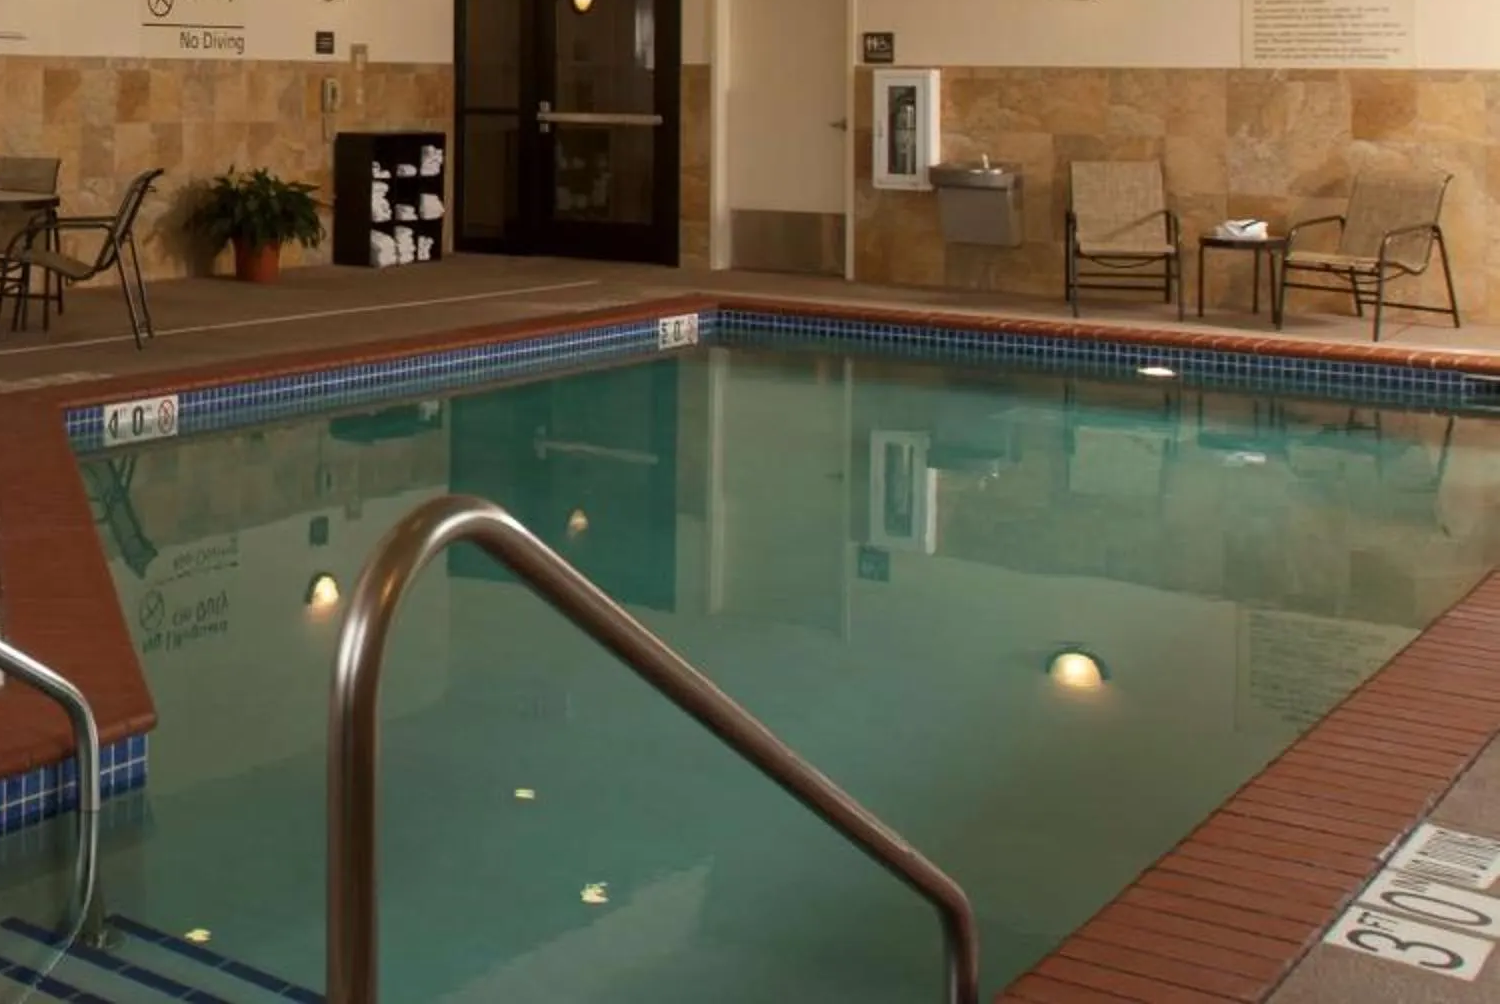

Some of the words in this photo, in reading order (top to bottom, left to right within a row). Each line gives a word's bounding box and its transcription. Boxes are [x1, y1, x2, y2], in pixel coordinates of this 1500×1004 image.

[179, 31, 200, 49] No
[202, 31, 245, 55] Diving
[1357, 911, 1399, 933] FT
[1345, 929, 1465, 970] 3
